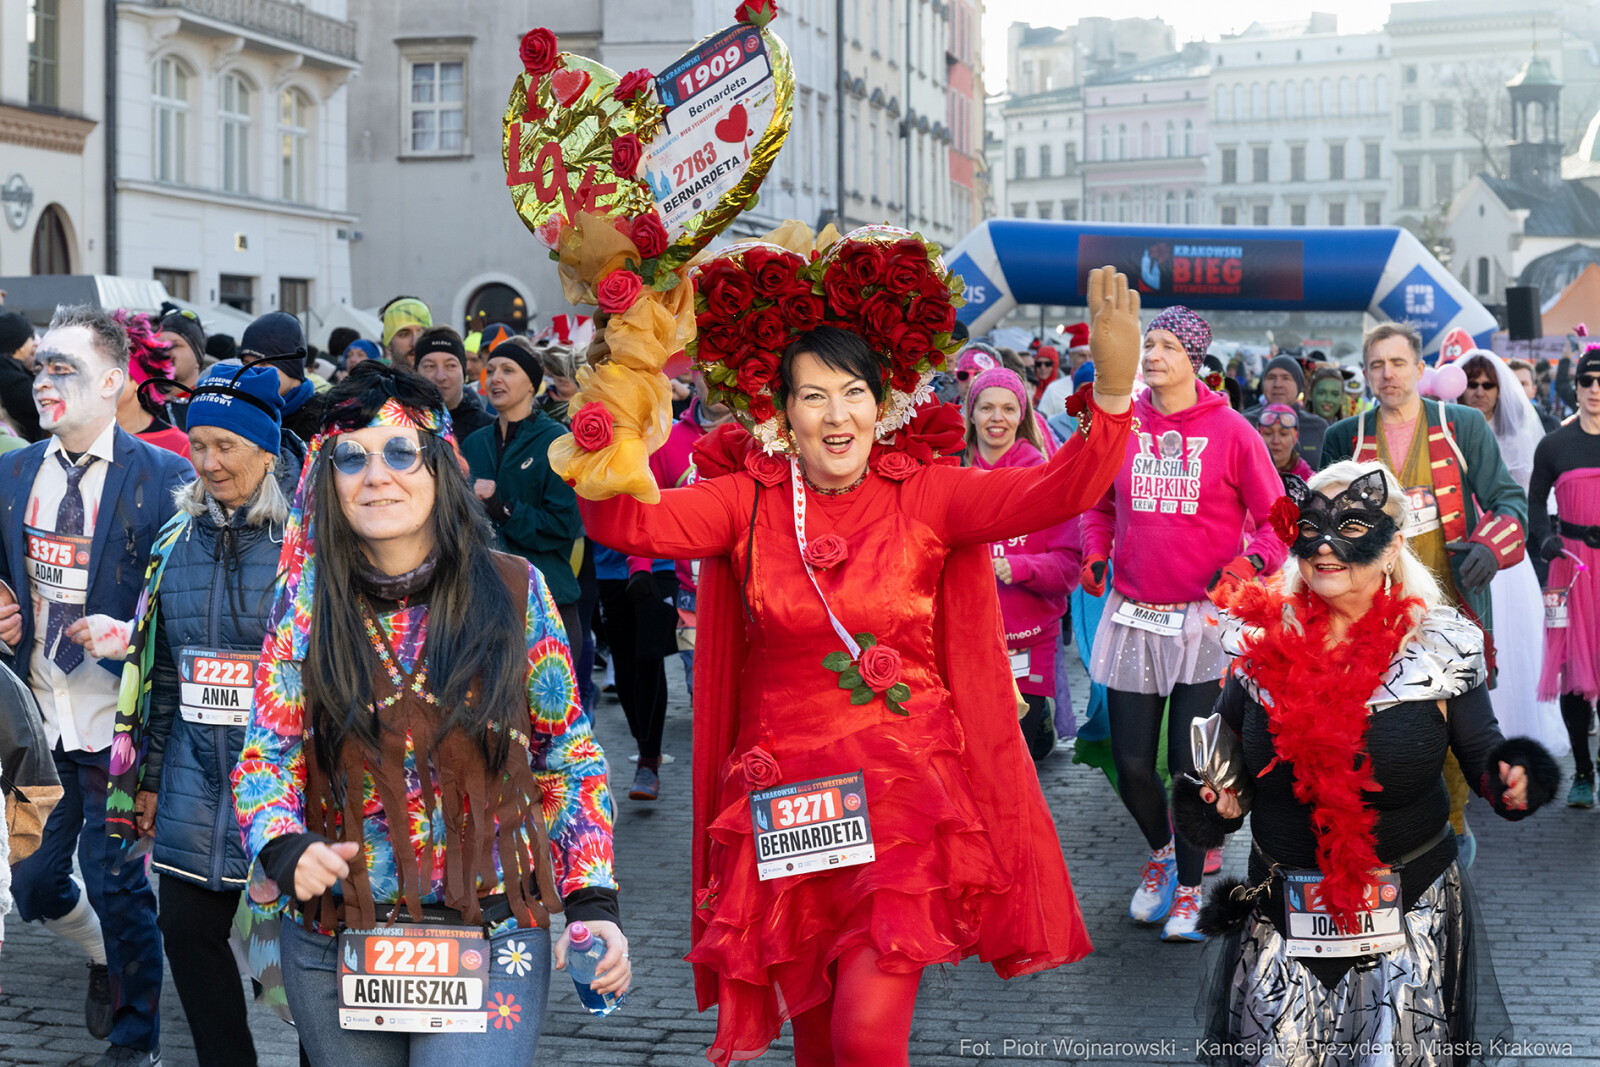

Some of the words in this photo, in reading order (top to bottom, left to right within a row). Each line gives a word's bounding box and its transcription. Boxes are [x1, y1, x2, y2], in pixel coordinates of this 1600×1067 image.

[665, 54, 701, 81] KRAKOWSKI
[681, 46, 741, 95] 1909
[688, 77, 747, 118] Bernardeta
[692, 105, 724, 130] SYLWESTROWY
[507, 123, 617, 229] LOVE
[672, 141, 717, 188] 2783
[663, 156, 741, 214] BERNARDETA
[1173, 245, 1243, 258] KRAKOWSKI
[1173, 257, 1243, 283] BIEG
[207, 376, 242, 388] KRAKOWKI
[1133, 458, 1200, 478] SMASHING
[1133, 500, 1155, 510] KREW
[1161, 502, 1176, 512] POT
[30, 538, 72, 566] 3375
[35, 562, 63, 585] ADAM
[1132, 607, 1171, 625] MARCIN
[189, 650, 217, 658] KRAKOWSKI
[229, 653, 260, 661] SYLWESTRO
[196, 659, 249, 685] 2222
[202, 687, 240, 707] ANNA
[762, 786, 797, 800] KRAKOWSKI
[797, 785, 812, 793] BIEG
[812, 776, 859, 790] SYLWESTROWY
[777, 791, 836, 826] 3271
[760, 820, 864, 857] BERNARDETA
[1295, 875, 1325, 883] KRAKOW
[355, 927, 404, 936] KRAKOWSKI
[404, 928, 424, 937] BIEG
[425, 928, 484, 940] SYLWESTROWY
[1311, 913, 1375, 937] JOAA
[374, 940, 449, 973] 2221
[354, 978, 468, 1006] AGNIESZKA
